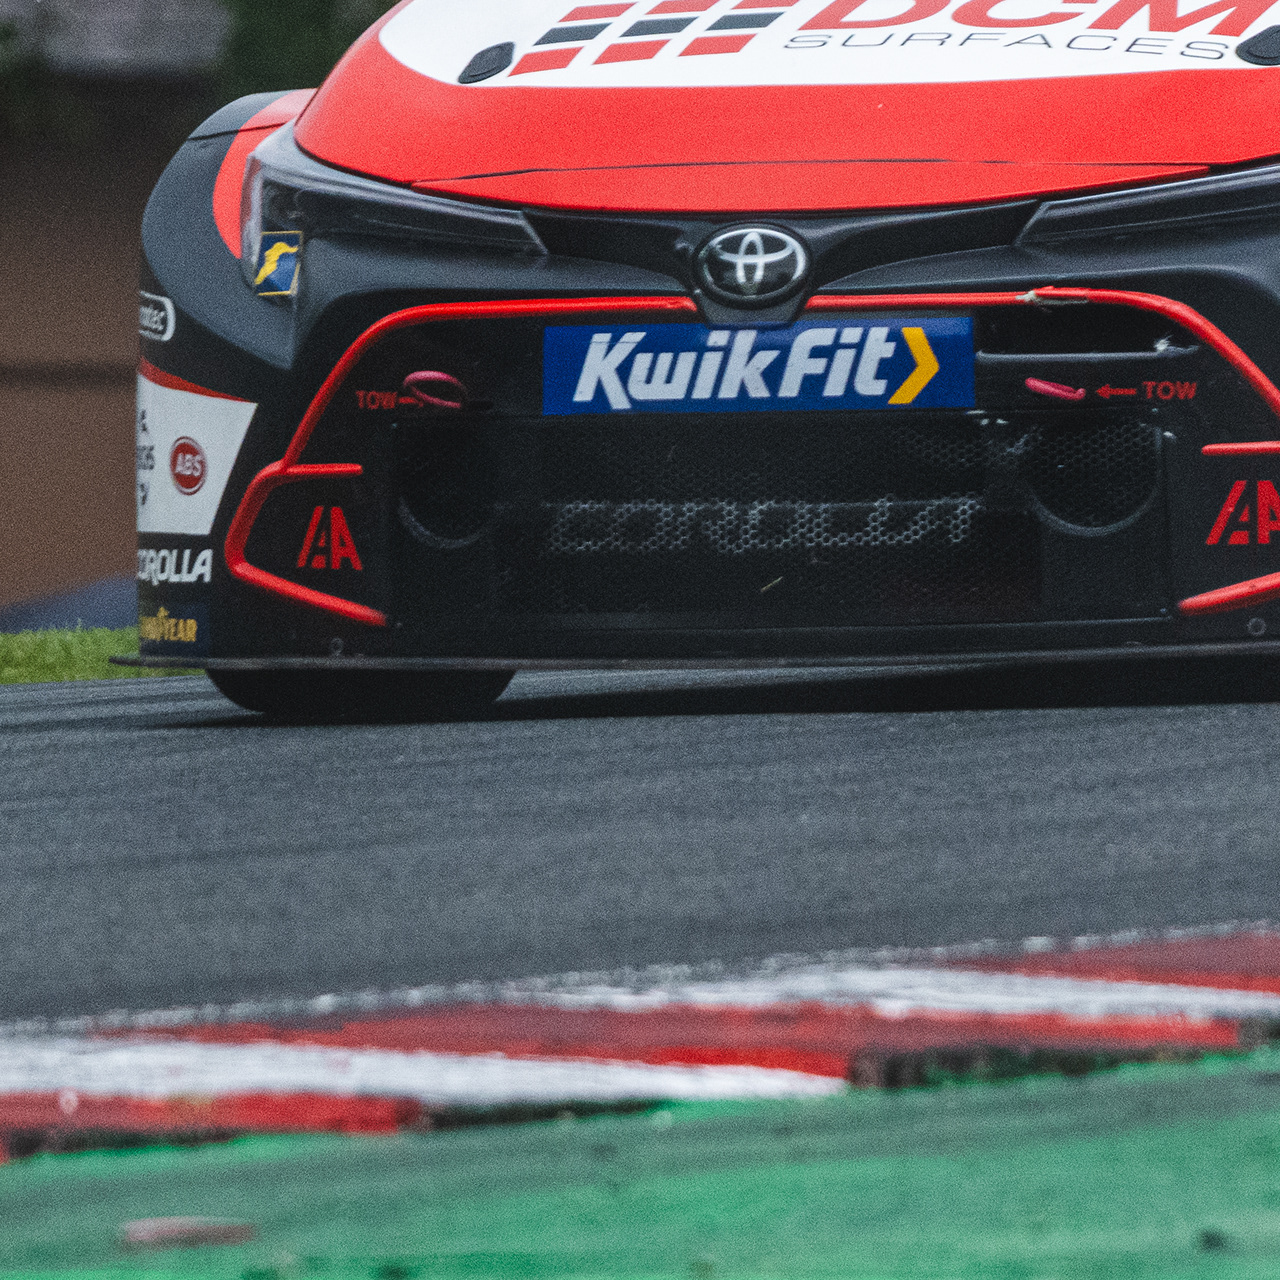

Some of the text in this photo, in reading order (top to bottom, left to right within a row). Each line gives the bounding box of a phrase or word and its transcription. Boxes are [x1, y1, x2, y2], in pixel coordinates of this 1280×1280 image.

[782, 32, 1231, 61] SURFACES
[571, 325, 897, 410] KwikFit
[355, 390, 398, 410] TOW
[1142, 381, 1198, 401] TOW
[175, 452, 201, 477] ABS
[138, 549, 213, 586] OROLLA
